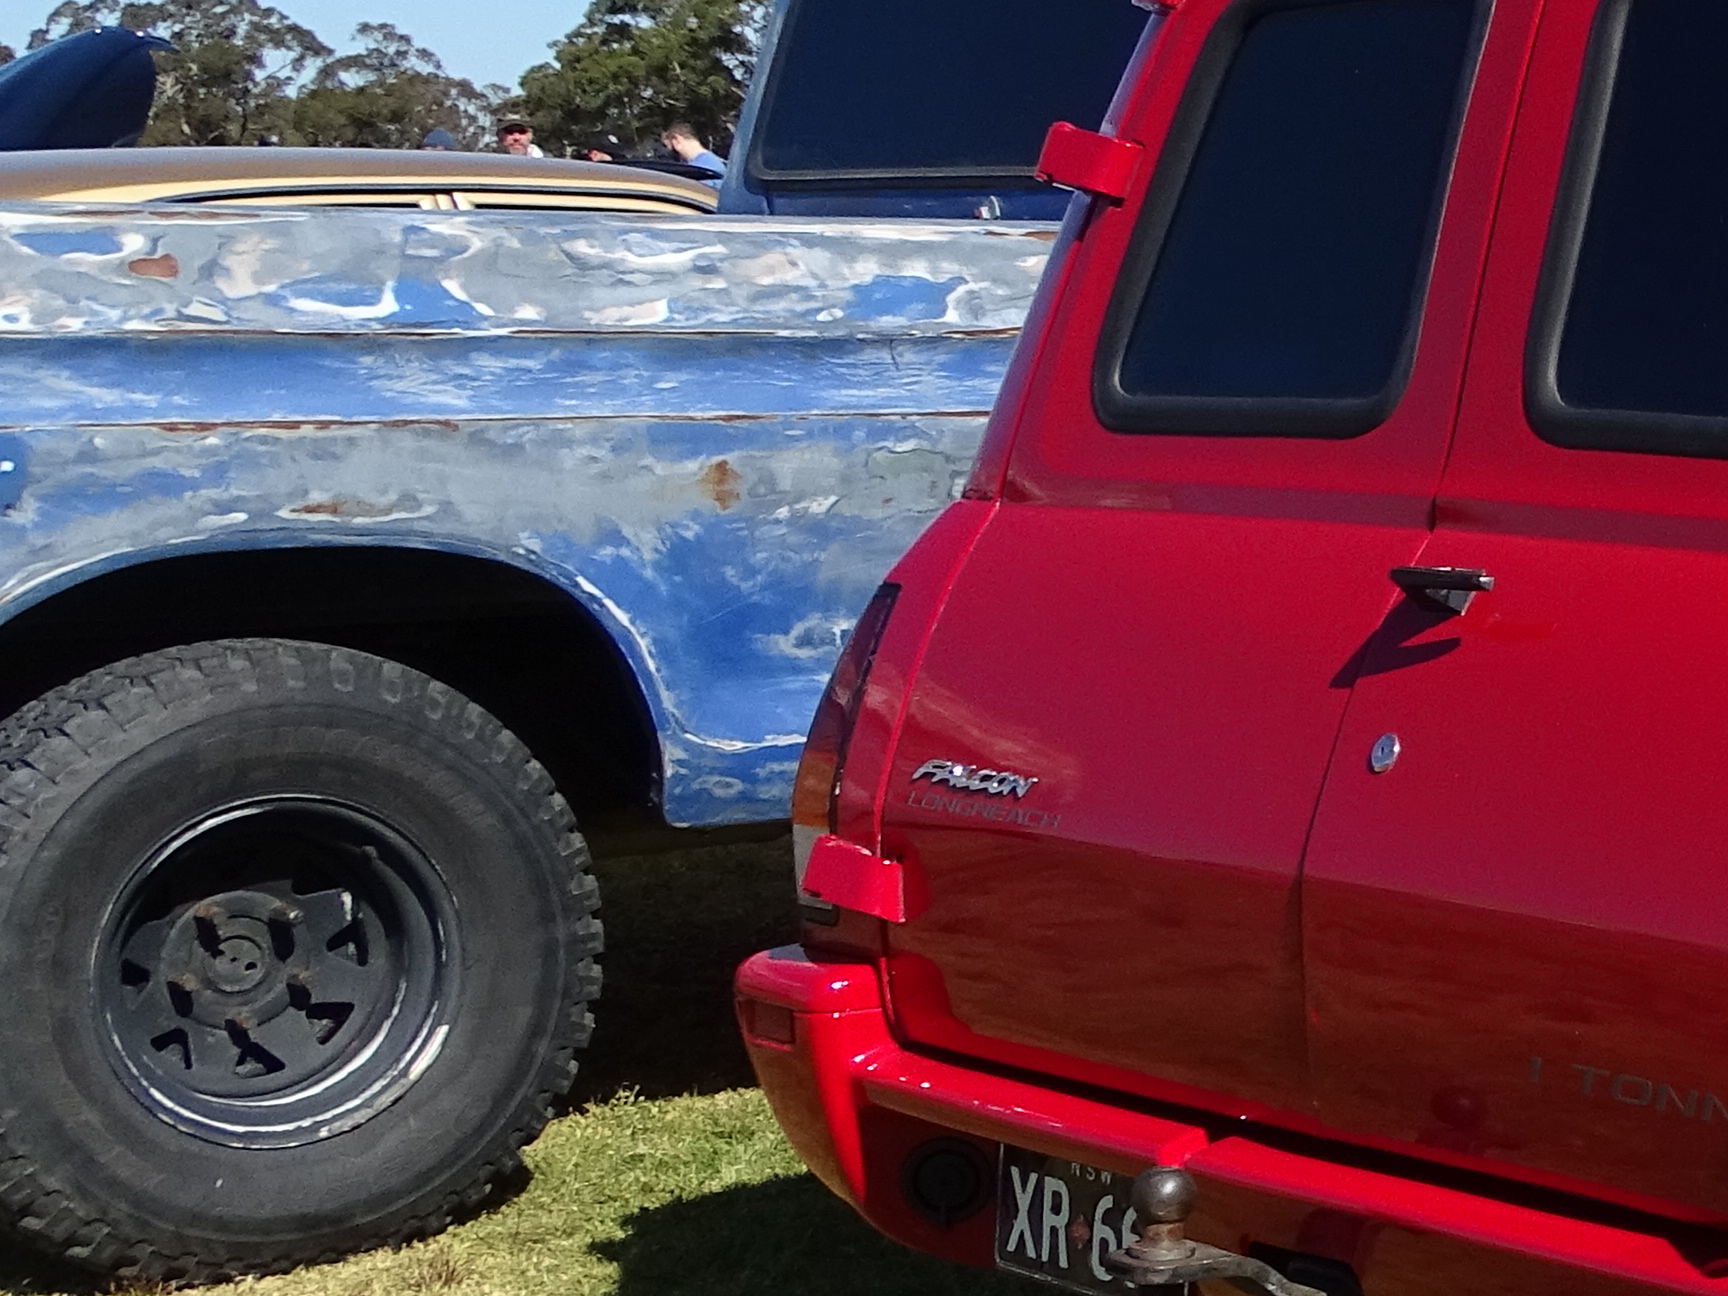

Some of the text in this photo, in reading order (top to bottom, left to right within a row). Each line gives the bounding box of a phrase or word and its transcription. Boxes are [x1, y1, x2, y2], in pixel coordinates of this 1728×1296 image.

[911, 759, 1039, 798] FALCON
[907, 791, 1062, 828] LONGREACH
[1071, 1162, 1112, 1185] NSW
